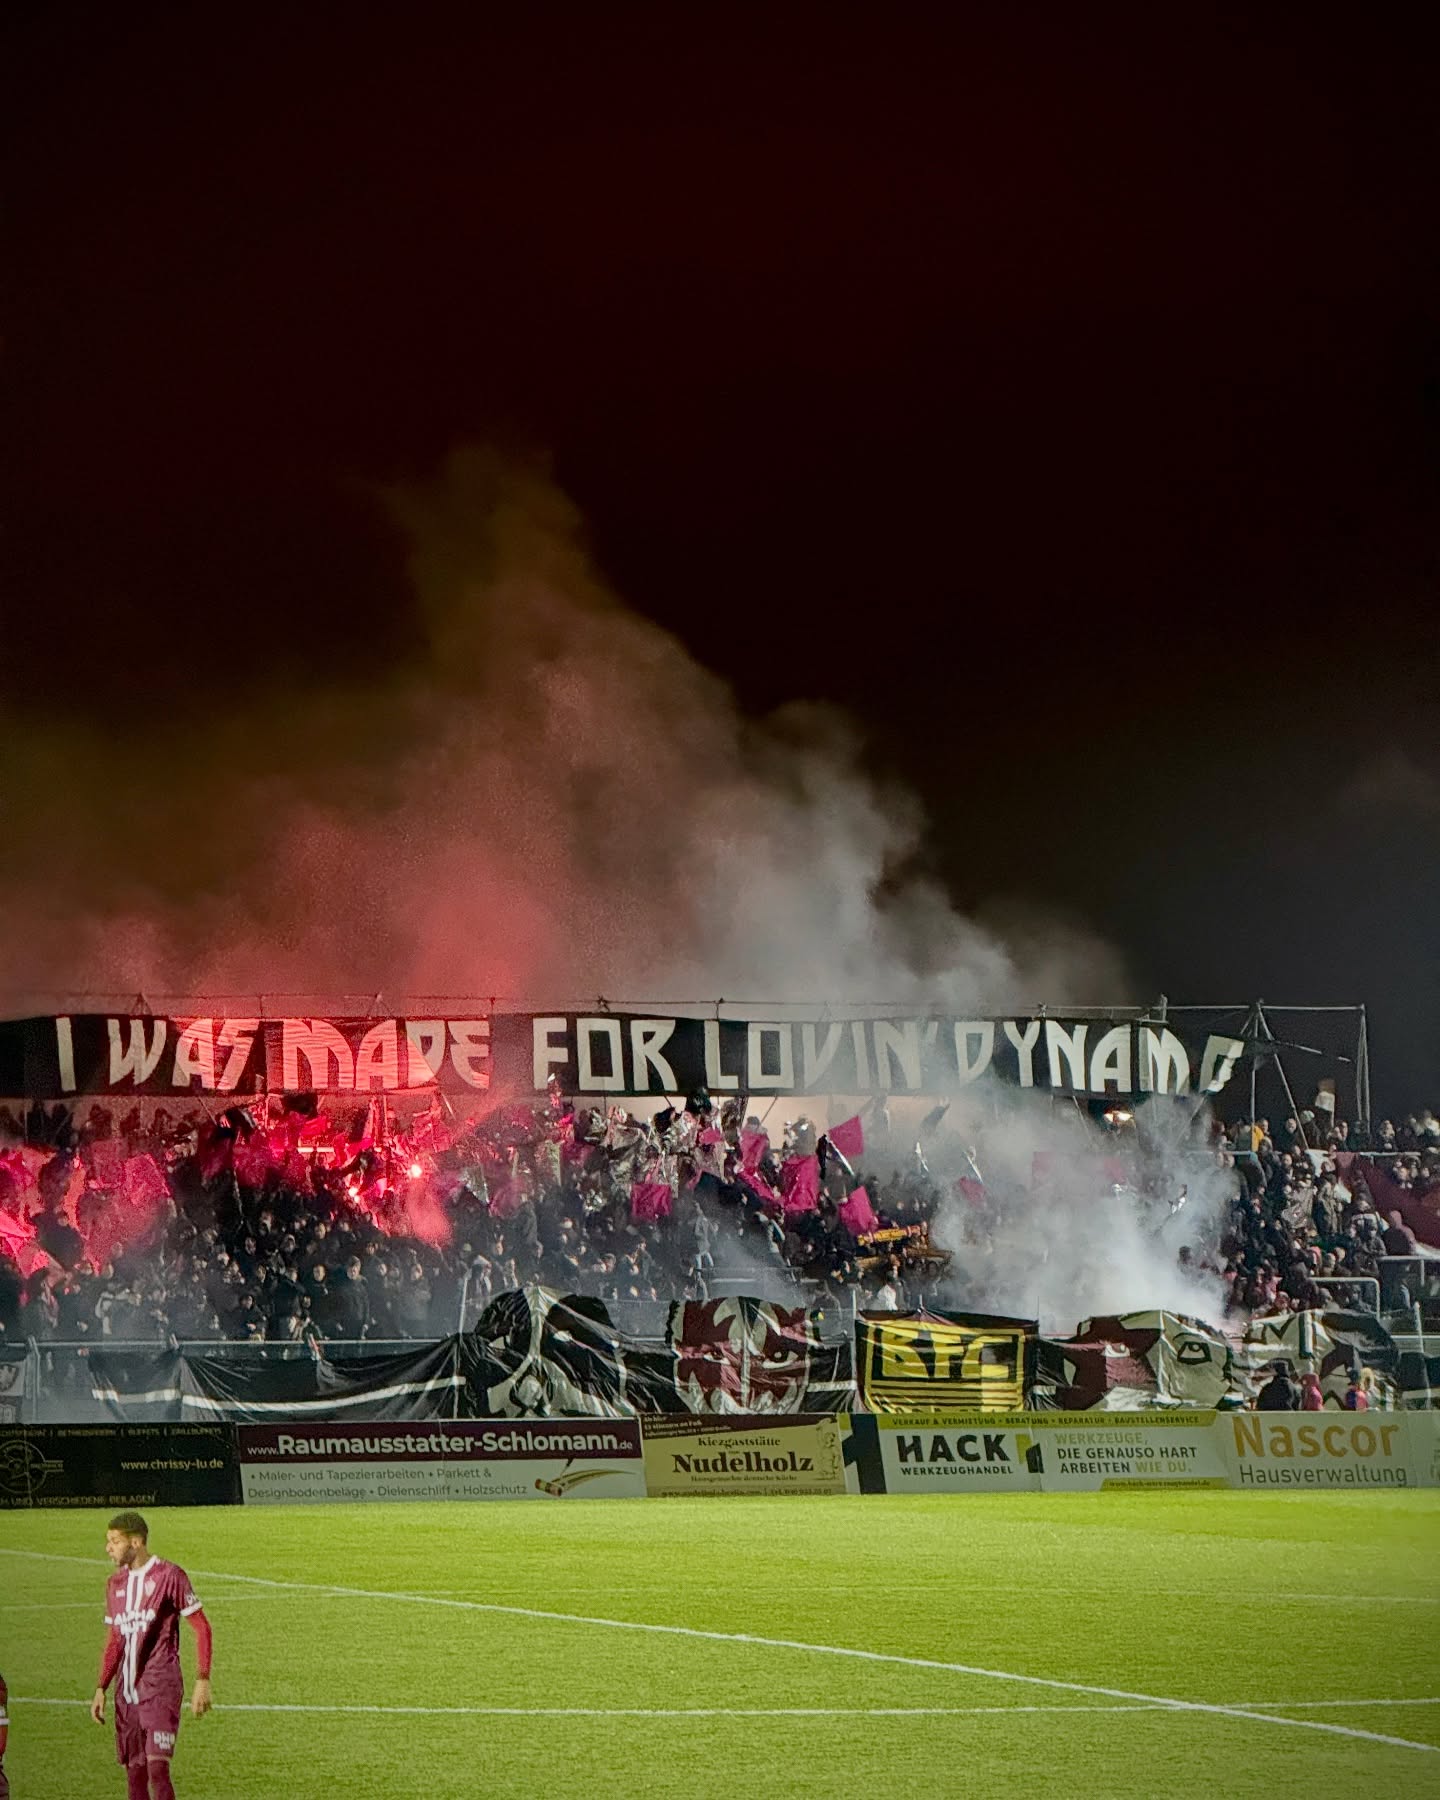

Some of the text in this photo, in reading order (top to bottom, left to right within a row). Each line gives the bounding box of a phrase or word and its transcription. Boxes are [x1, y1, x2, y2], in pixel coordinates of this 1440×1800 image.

[56, 1017, 76, 1092] I
[108, 1018, 258, 1091] WAS
[282, 1018, 490, 1091] MADE
[533, 1018, 678, 1092] FOR
[892, 1418, 930, 1426] VERKAUF
[942, 1417, 996, 1425] VERMIETUNG
[1005, 1417, 1049, 1425] BERATUNG
[1058, 1416, 1105, 1425] REPARATUR
[1114, 1415, 1199, 1425] BAUSTELLENSERVICE
[248, 1431, 633, 1456] www.Raumausstatter-Schlomann.de
[698, 1436, 781, 1449] Kiezgaststätte
[1054, 1432, 1149, 1445] WERKZEUGE,
[1232, 1415, 1399, 1458] Nascor
[896, 1434, 1011, 1463] HACK
[1058, 1447, 1198, 1460] DIE GENAUSO HART
[121, 1458, 225, 1472] www.chrissy-lu.de
[671, 1451, 814, 1474] Nudelholz
[1060, 1460, 1192, 1474] ARBEITEN WIE DU.
[259, 1468, 492, 1483] Maler- und Tapezierarbeiten Parkett &
[900, 1465, 1014, 1476] WERKZEUGHANDEL
[1240, 1464, 1407, 1488] Hausverwaltung
[248, 1484, 528, 1500] Designbodenbeläge Dielenschliff Holzschutz
